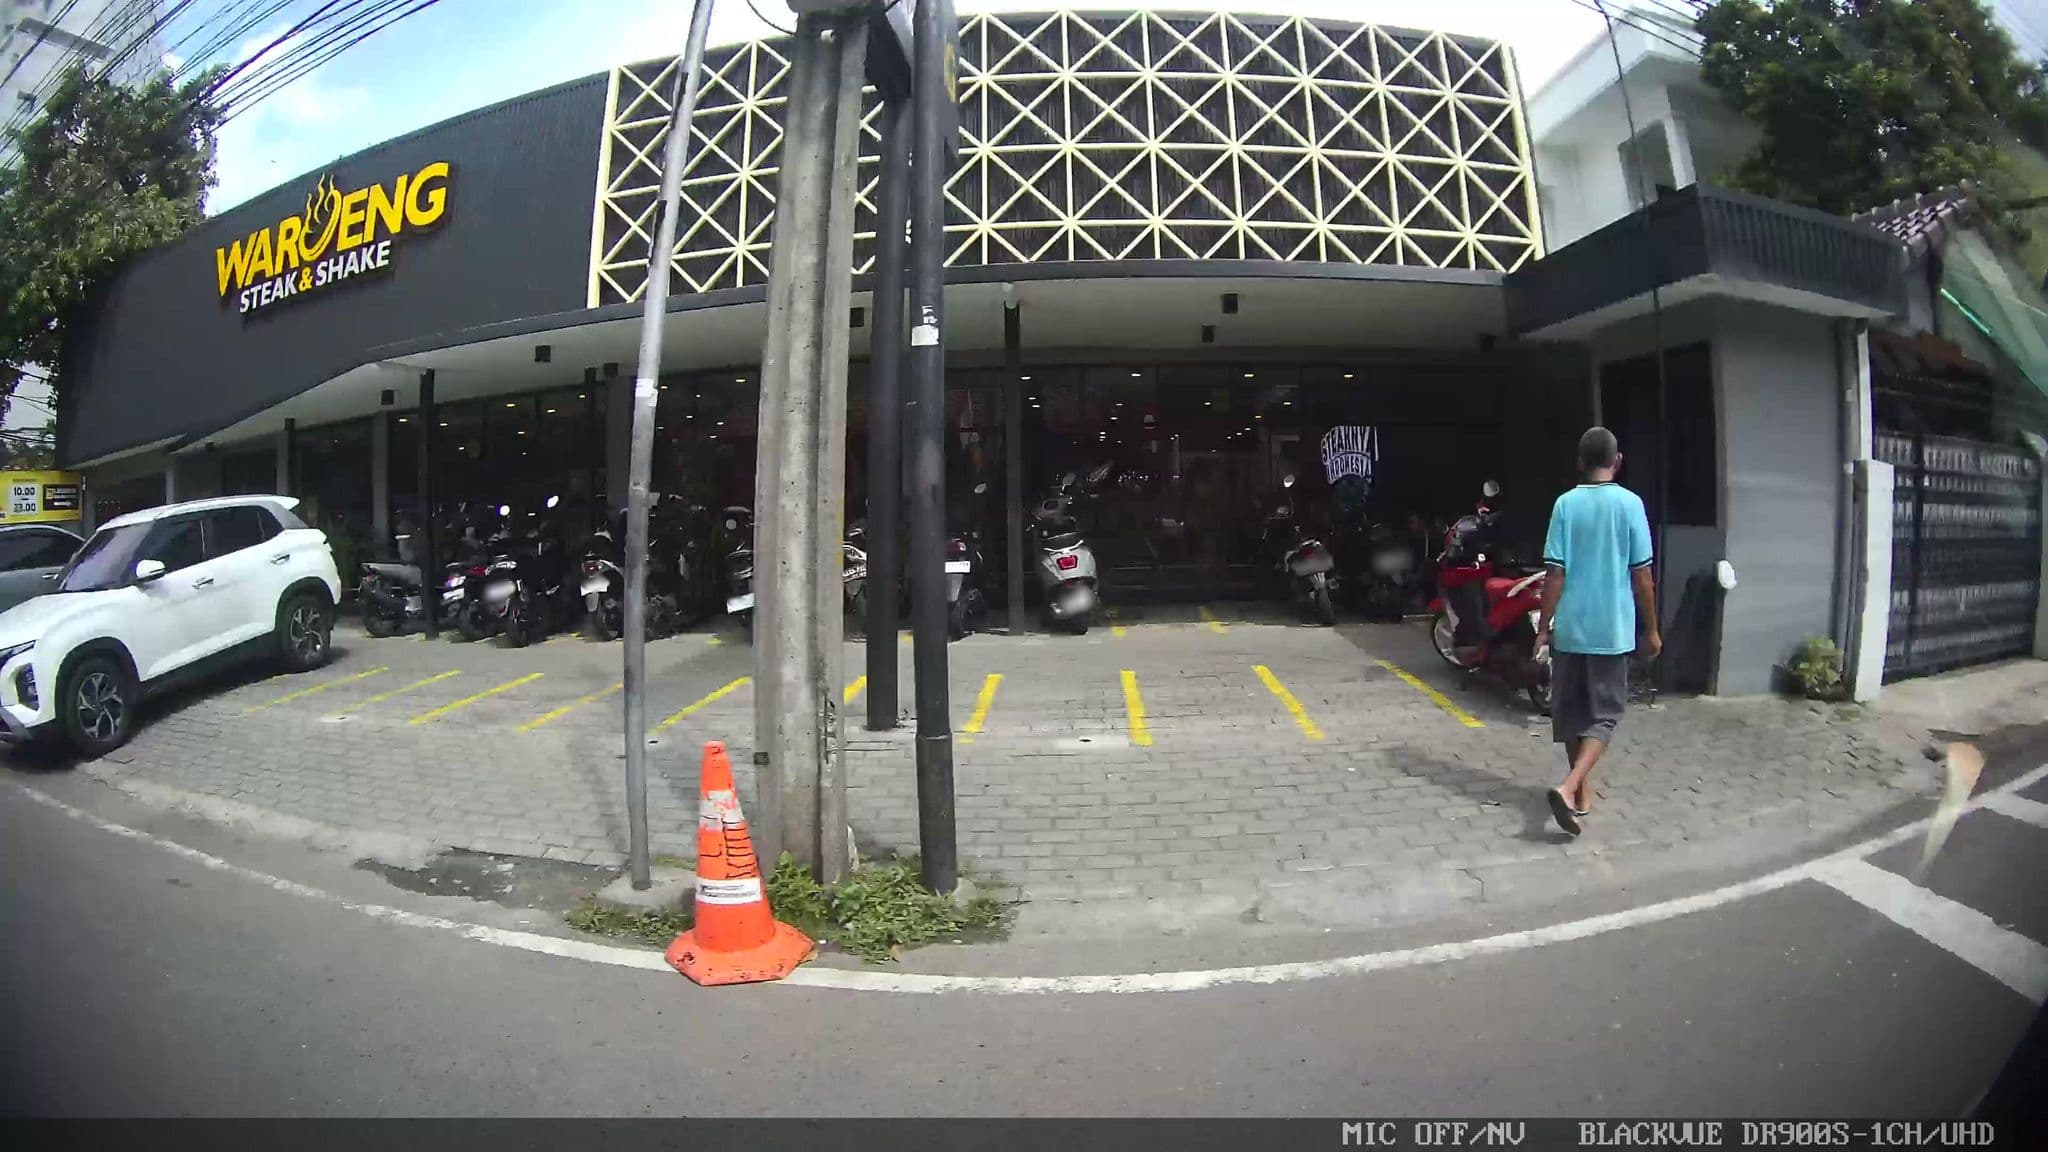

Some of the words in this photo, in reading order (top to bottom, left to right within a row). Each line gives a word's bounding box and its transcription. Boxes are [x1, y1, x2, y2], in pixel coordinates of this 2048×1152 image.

[216, 162, 450, 297] WAROENG
[239, 271, 298, 314] STEAK
[315, 240, 392, 288] SHAKE
[13, 486, 36, 496] 10.00
